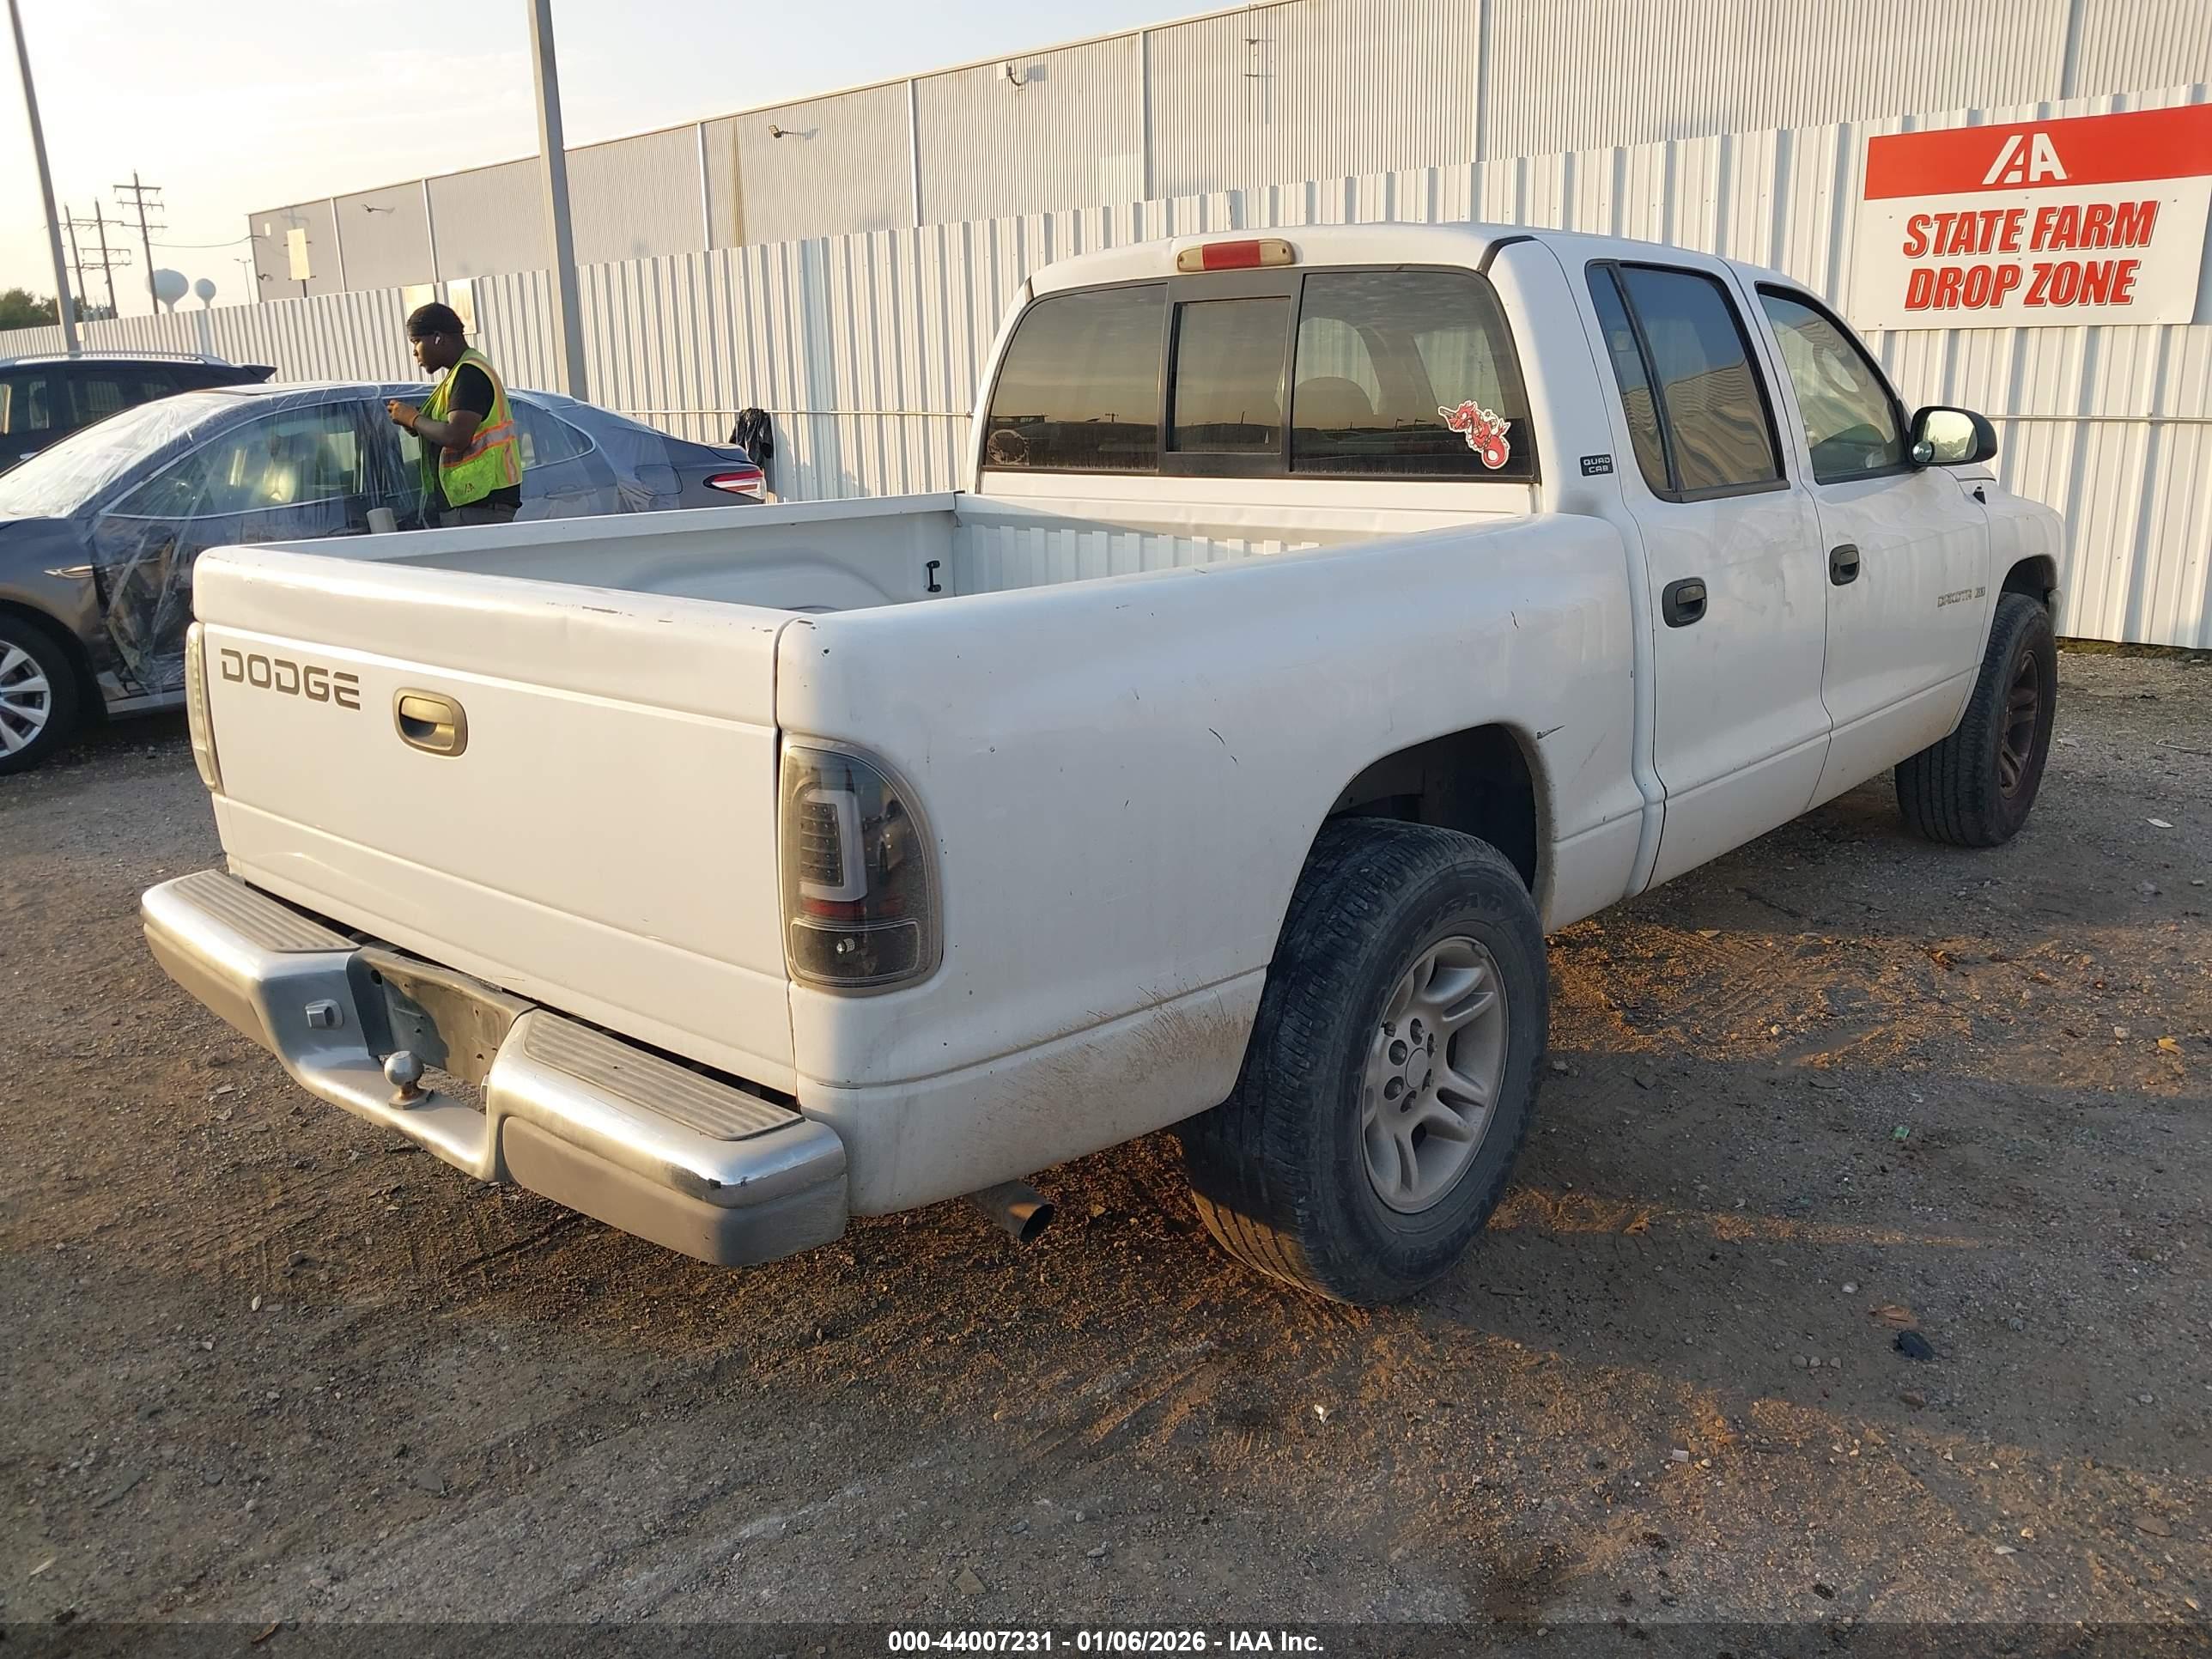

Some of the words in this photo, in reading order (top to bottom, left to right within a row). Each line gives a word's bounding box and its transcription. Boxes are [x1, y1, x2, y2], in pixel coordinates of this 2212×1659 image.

[1903, 205, 2026, 258] STATE
[2029, 200, 2160, 252] FARM
[1904, 264, 2022, 311] DROP
[2023, 258, 2142, 308] ZONE
[1583, 457, 1611, 466] QUAD
[1588, 465, 1609, 473] CAB
[221, 648, 361, 711] DODGE
